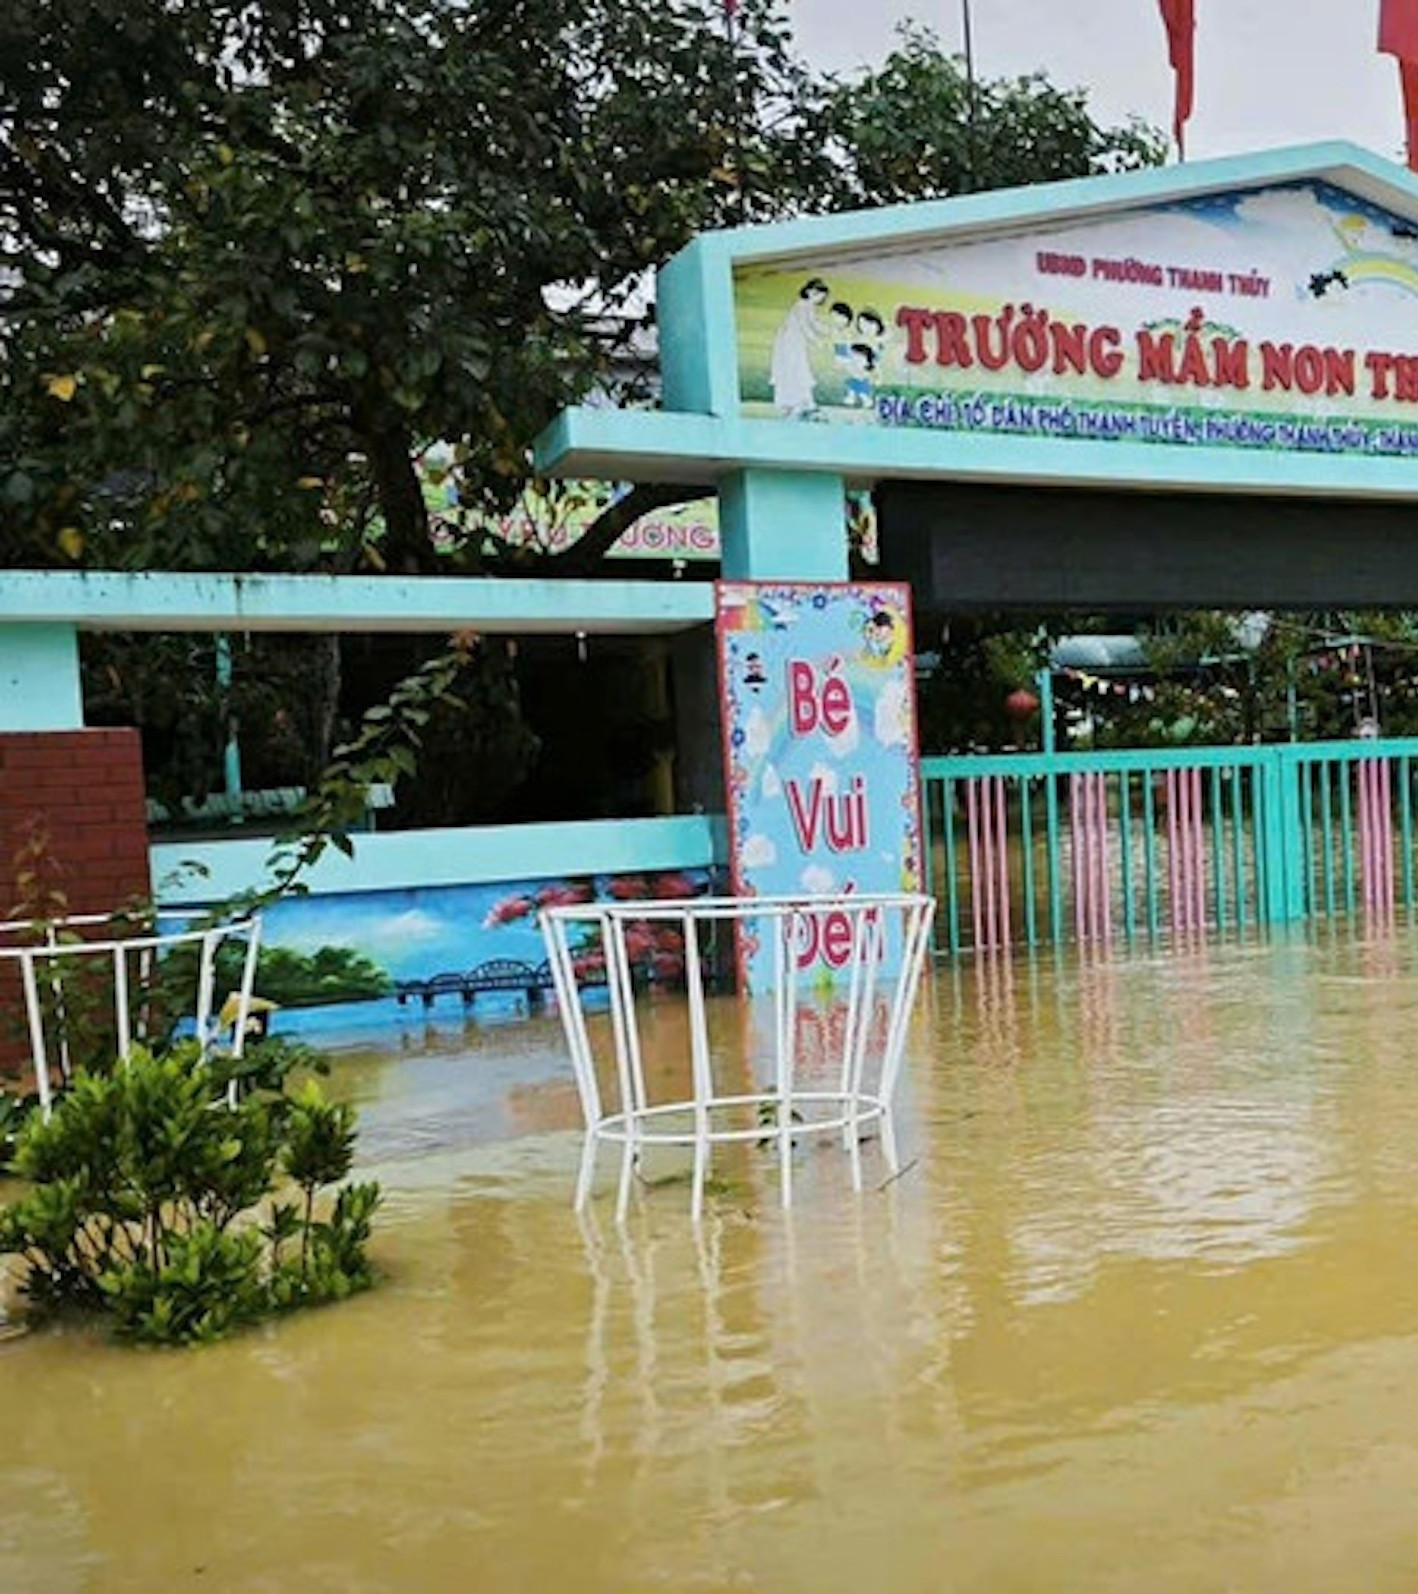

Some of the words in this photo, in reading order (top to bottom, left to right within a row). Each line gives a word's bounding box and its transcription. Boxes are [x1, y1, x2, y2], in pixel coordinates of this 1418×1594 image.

[1036, 252, 1087, 278] UBND
[1093, 257, 1163, 286] PHƯỜNG
[1166, 266, 1223, 292] THANH
[896, 303, 1124, 379] TRƯỜNG
[1136, 306, 1249, 388] MẦM
[1260, 341, 1356, 397] NON
[787, 656, 851, 738] Bé
[785, 776, 870, 851] Vui
